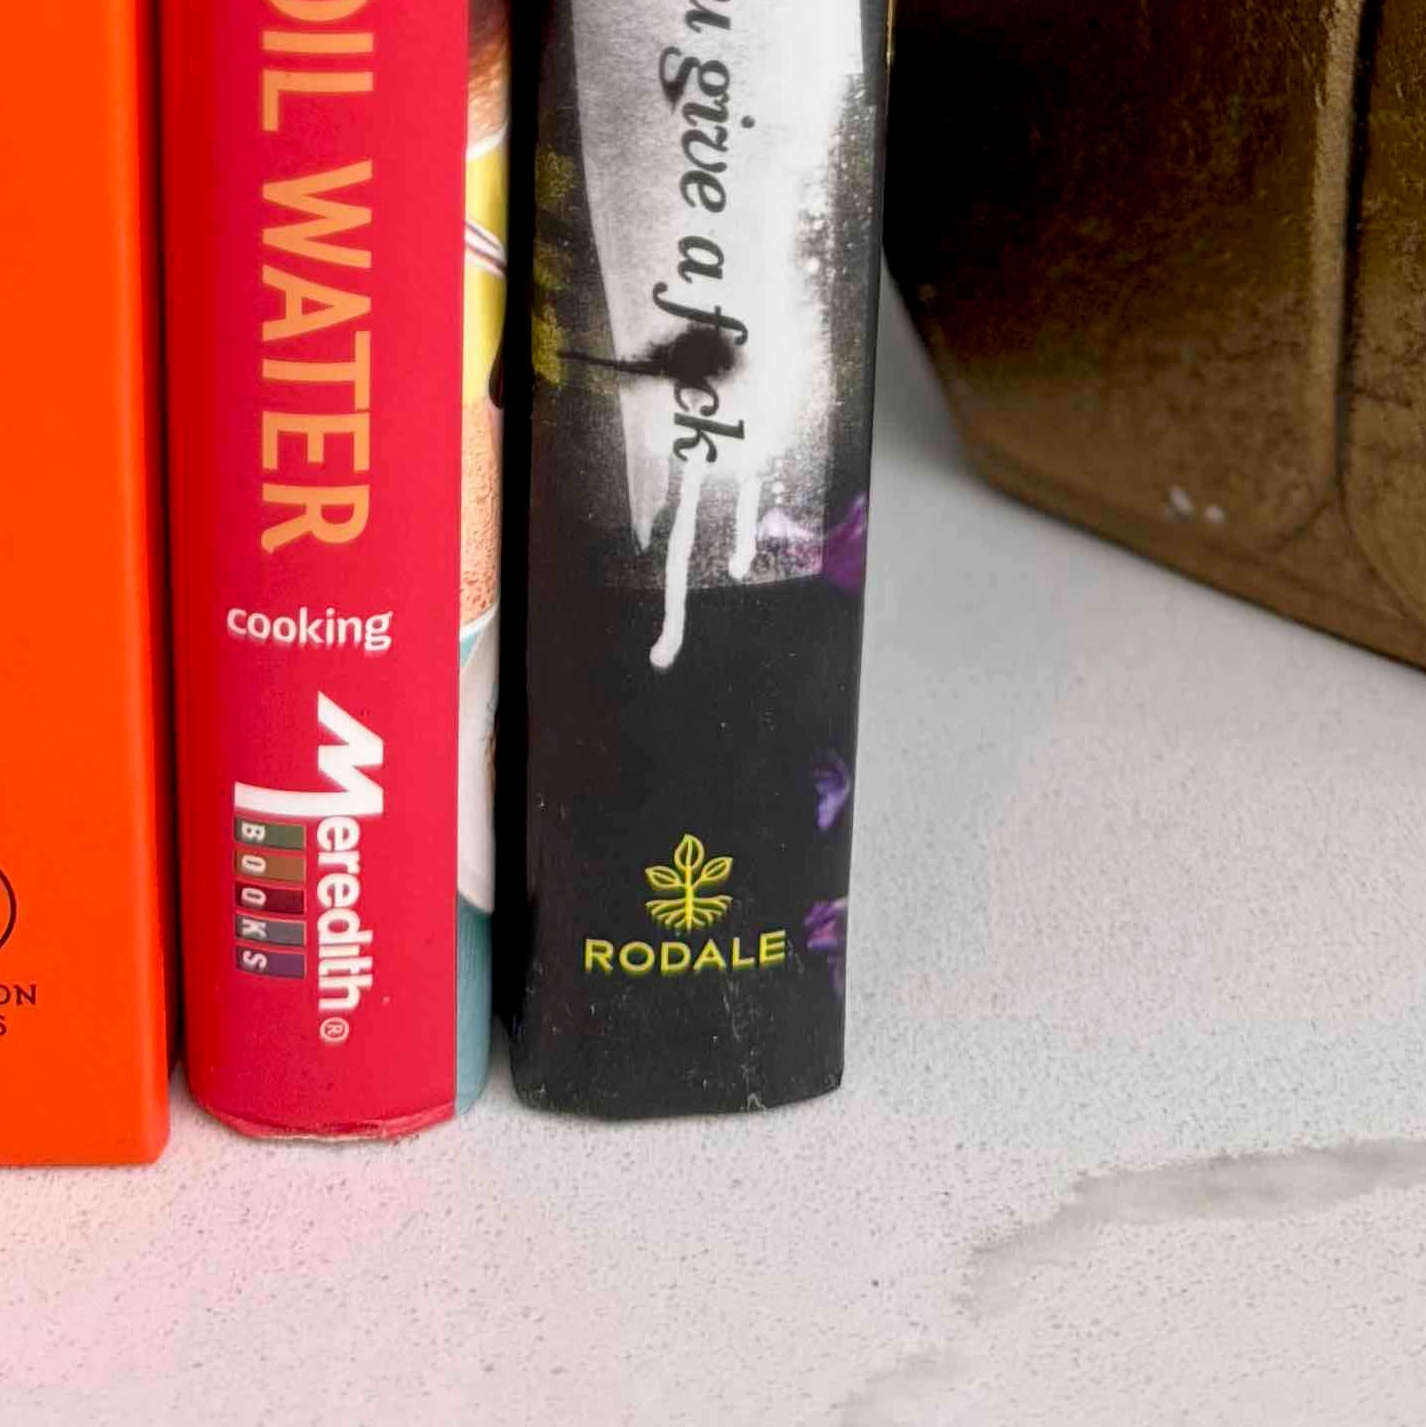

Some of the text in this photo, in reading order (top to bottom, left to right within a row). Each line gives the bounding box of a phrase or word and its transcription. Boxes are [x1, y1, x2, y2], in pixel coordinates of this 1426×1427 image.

[658, 46, 756, 214] give
[677, 235, 725, 284] a
[260, 158, 374, 553] WATER
[652, 281, 749, 464] fck
[226, 606, 394, 652] cooking
[238, 820, 269, 973] BOOKS
[583, 928, 787, 975] RODALE
